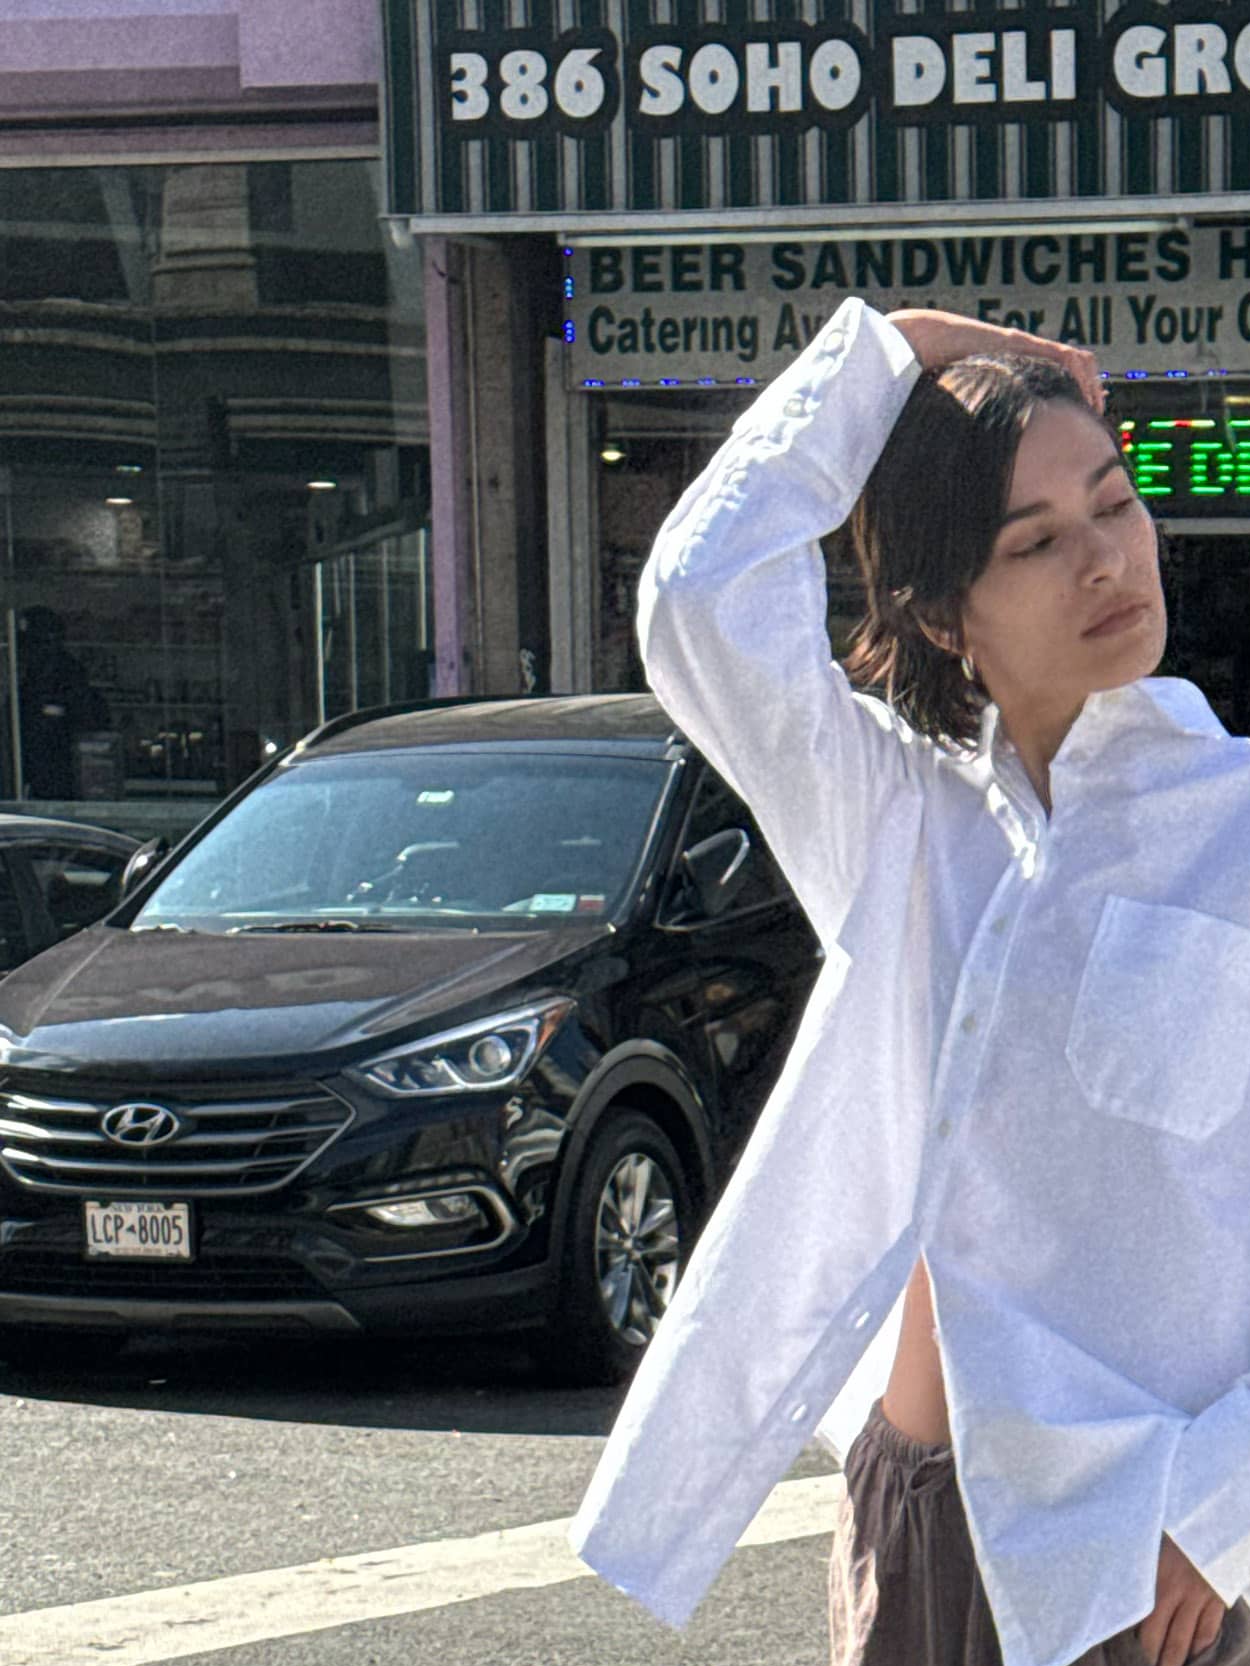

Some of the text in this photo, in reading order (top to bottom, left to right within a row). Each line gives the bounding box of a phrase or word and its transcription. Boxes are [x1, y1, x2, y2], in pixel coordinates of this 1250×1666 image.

[451, 48, 605, 120] 386
[639, 39, 861, 116] SOHO
[892, 30, 1075, 106] DELI
[588, 243, 746, 293] BEER
[771, 228, 1192, 290] SANDWICHES
[587, 303, 759, 362] Catering
[1059, 295, 1112, 345] All
[1126, 293, 1223, 345] Your
[91, 1213, 184, 1245] LCP 8005
